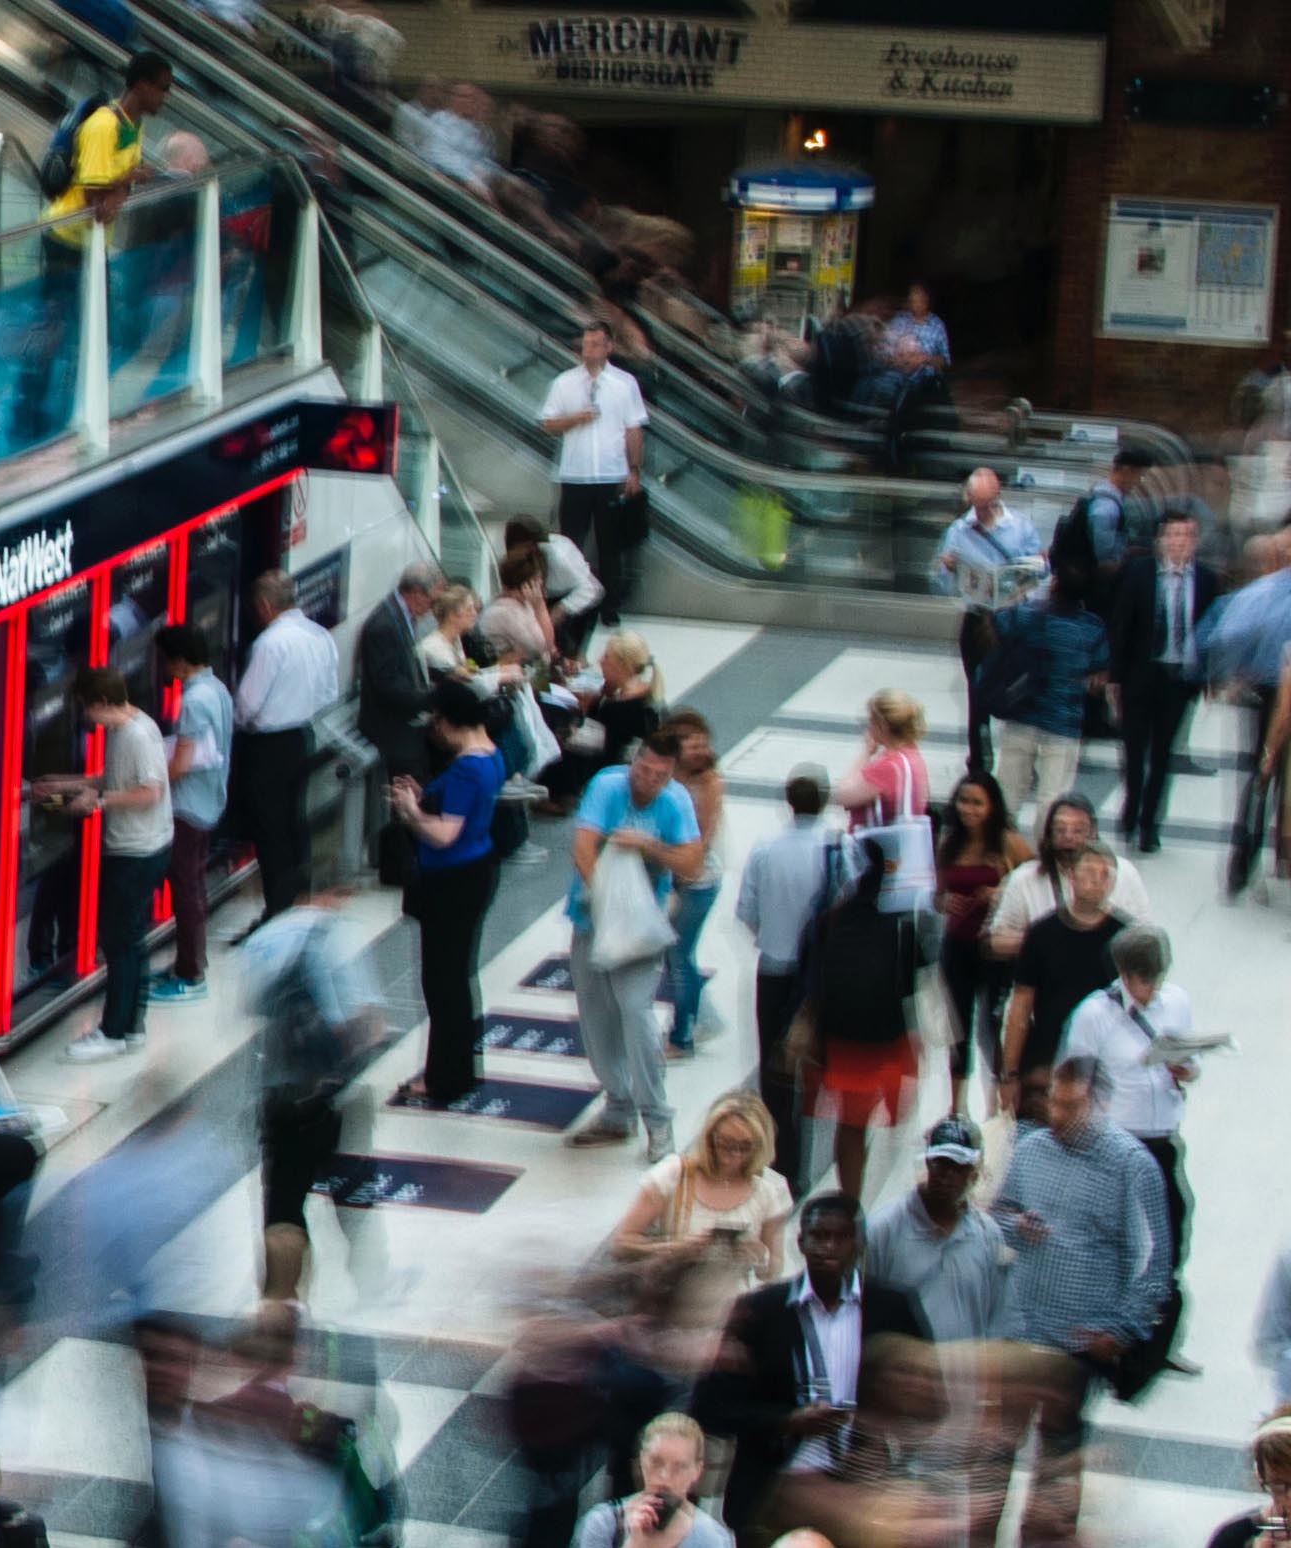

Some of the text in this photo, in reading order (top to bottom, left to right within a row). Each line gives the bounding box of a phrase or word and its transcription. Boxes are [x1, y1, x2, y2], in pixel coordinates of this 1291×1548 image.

[528, 16, 747, 64] MERCHANT
[885, 41, 1019, 71] Freehouse
[555, 58, 714, 88] BISHOPSGATE
[890, 67, 1014, 96] & Kitchen
